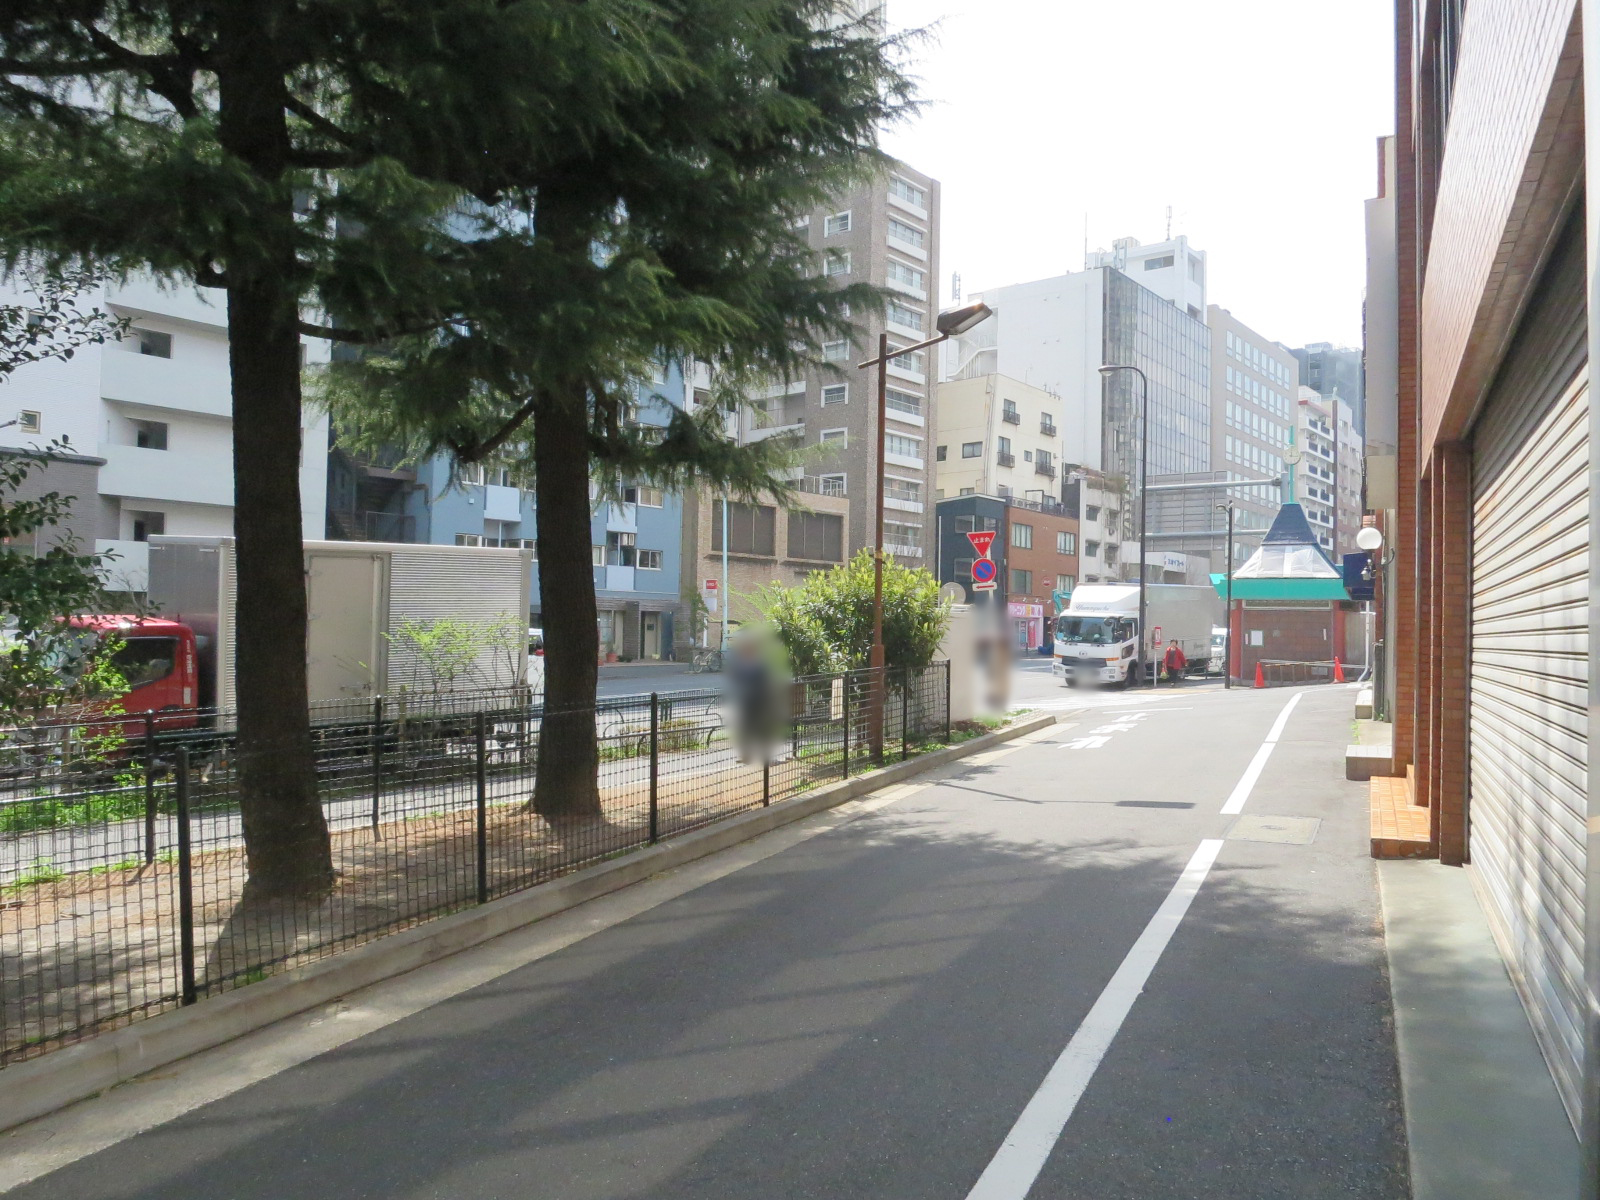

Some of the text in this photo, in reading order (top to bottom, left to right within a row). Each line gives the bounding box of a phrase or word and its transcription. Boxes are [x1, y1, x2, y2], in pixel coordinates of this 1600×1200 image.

[973, 536, 991, 544] 止まれ
[1057, 713, 1148, 749] 止まれ
